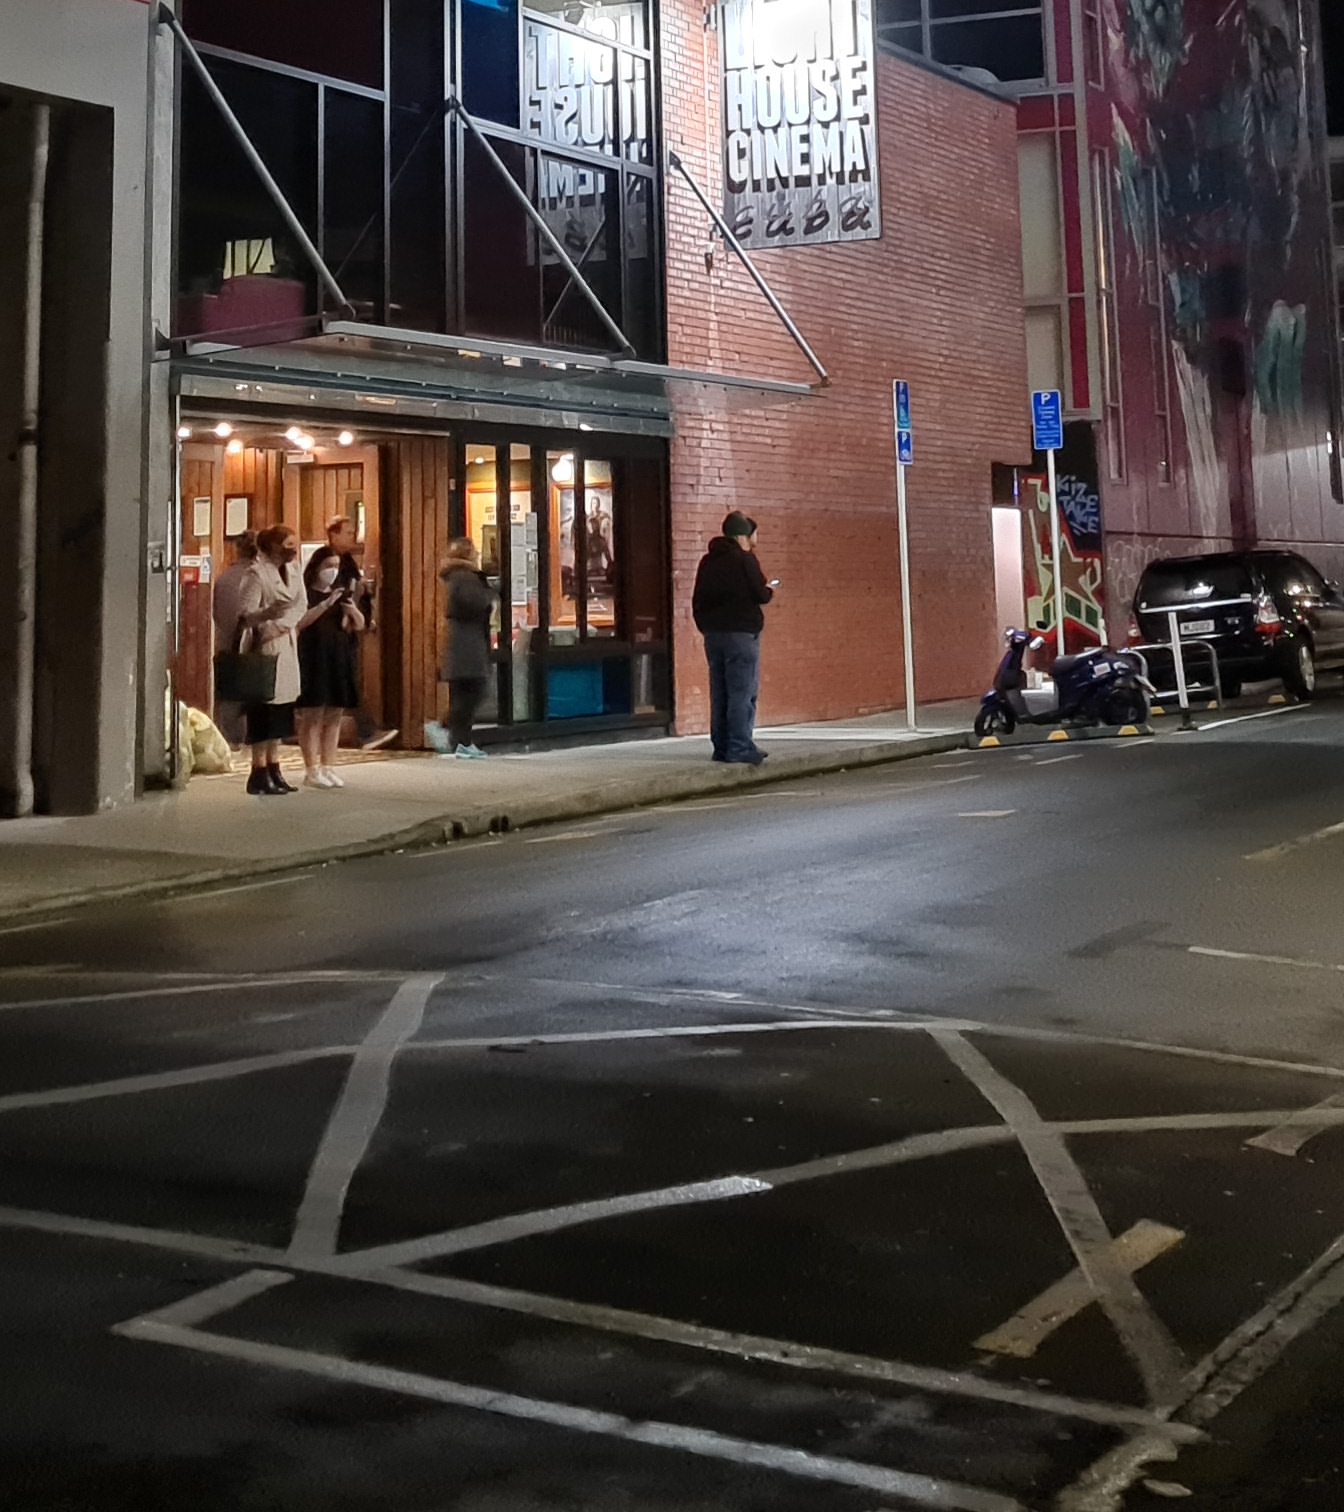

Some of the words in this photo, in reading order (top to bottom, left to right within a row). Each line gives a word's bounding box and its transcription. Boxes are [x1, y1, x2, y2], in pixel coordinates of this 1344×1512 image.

[726, 55, 866, 131] HOUSE
[727, 120, 869, 188] CINEMA
[1041, 393, 1051, 405] P
